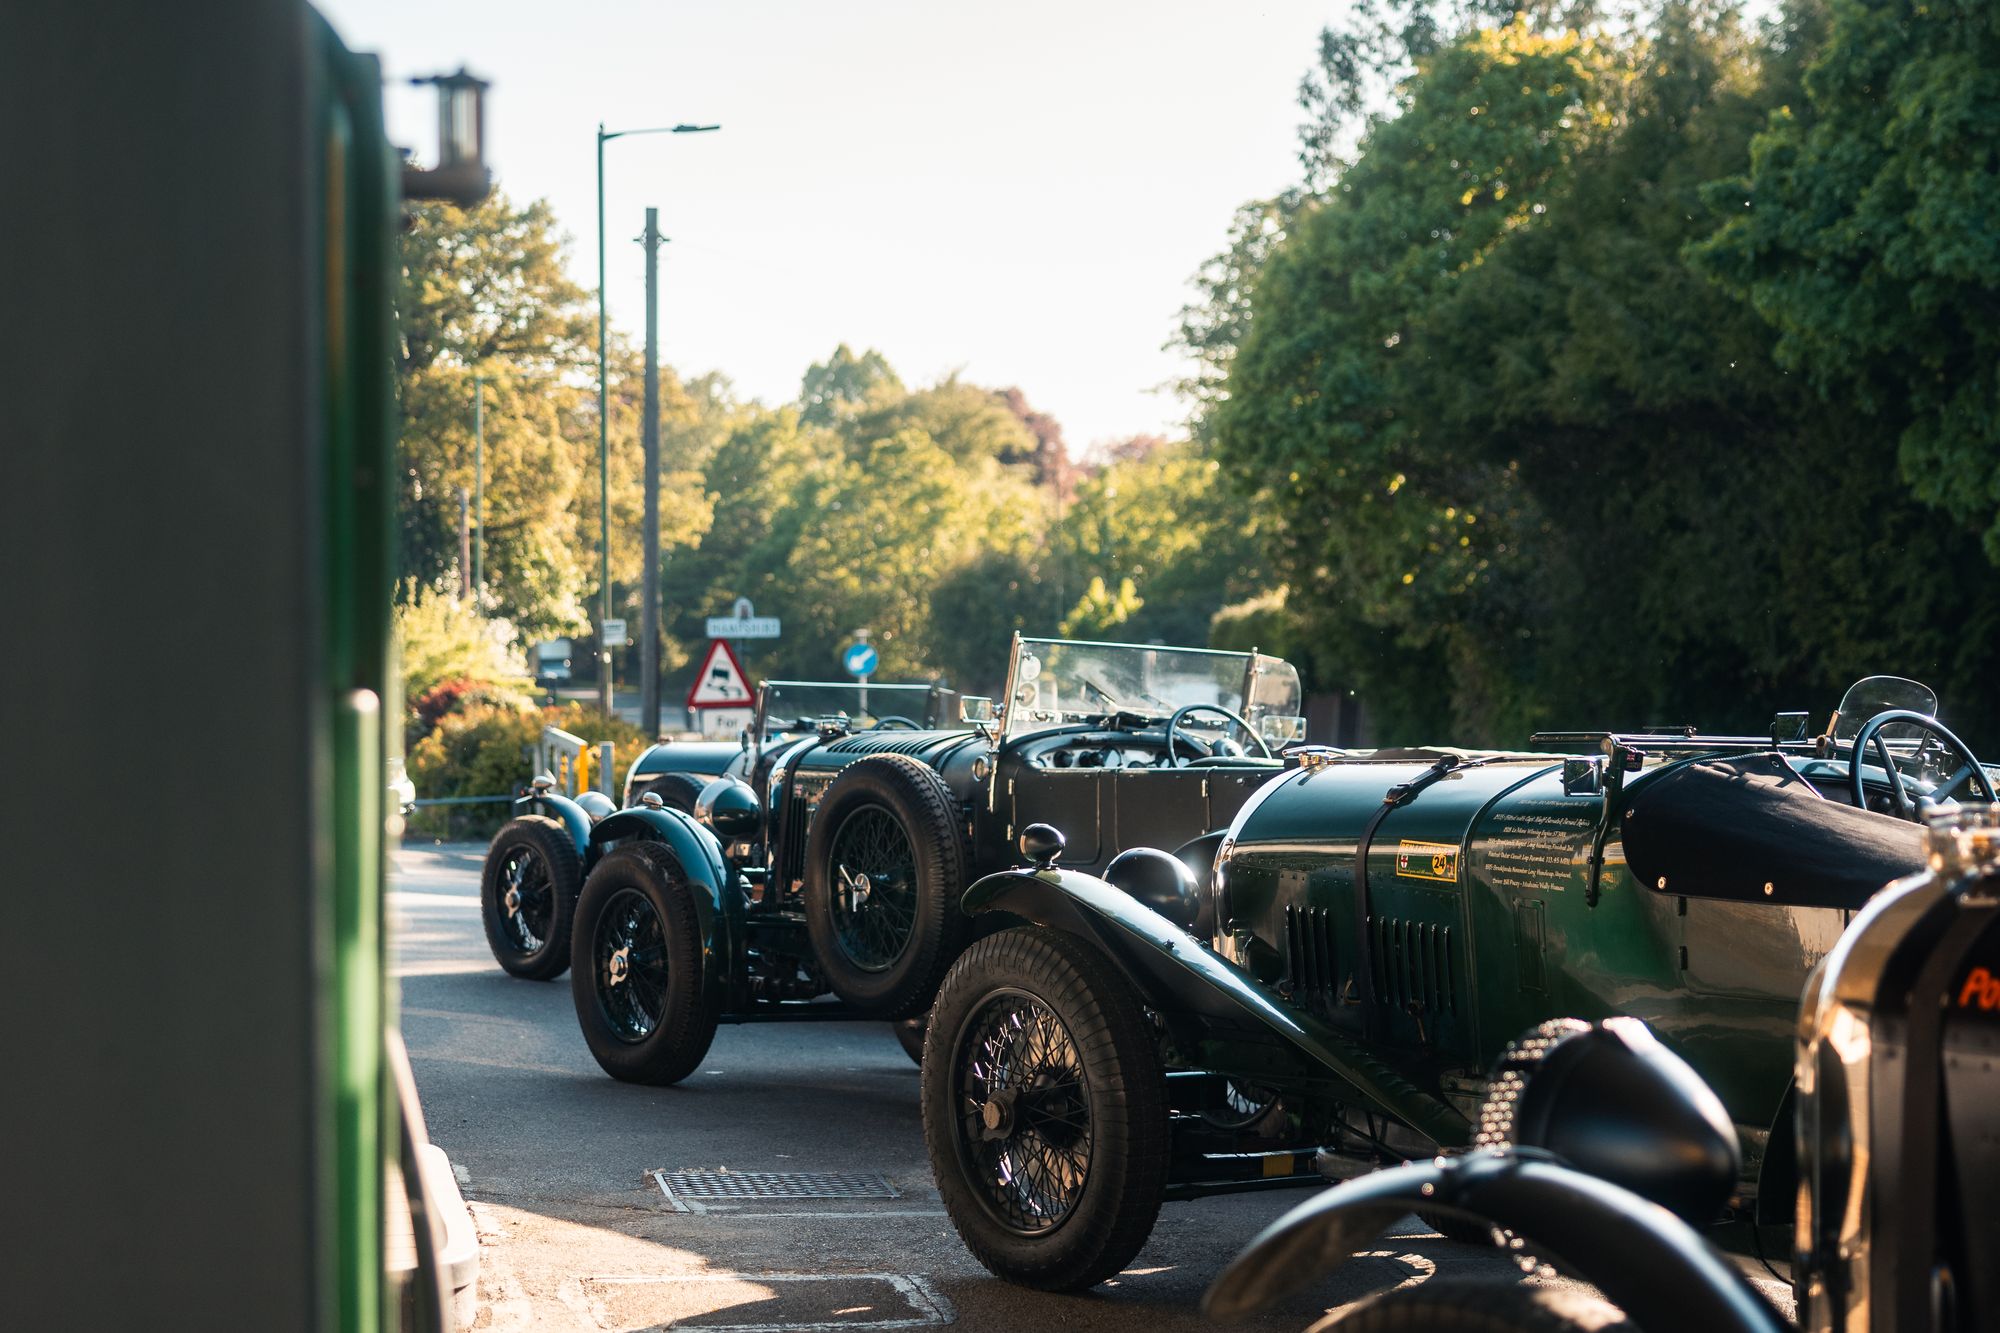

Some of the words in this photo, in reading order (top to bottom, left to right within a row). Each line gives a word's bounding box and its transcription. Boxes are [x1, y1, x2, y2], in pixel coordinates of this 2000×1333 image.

[716, 714, 738, 728] For
[1434, 856, 1445, 869] 24
[1958, 968, 2000, 1010] Po
